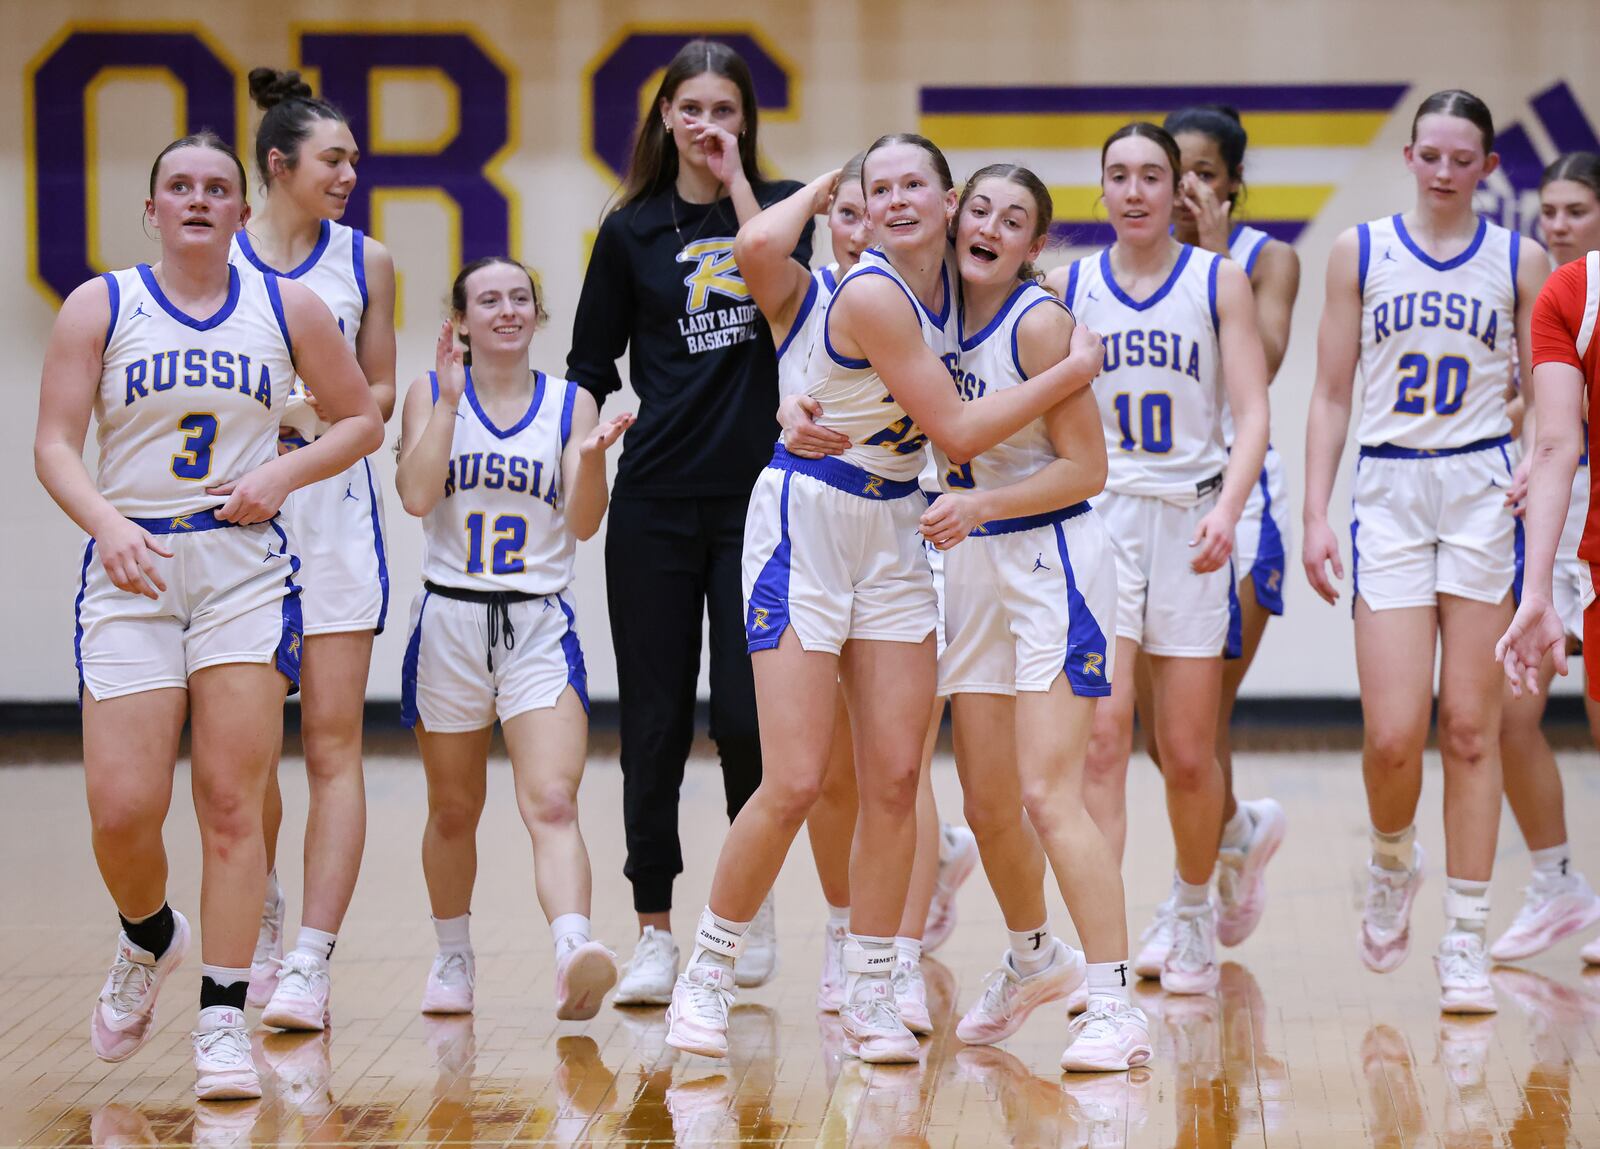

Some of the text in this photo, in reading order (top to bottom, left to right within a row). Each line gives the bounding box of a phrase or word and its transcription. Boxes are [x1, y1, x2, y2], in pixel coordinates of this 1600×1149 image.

[678, 311, 716, 336] LADY
[1373, 290, 1498, 352] RUSSIA
[124, 348, 273, 411] RUSSIA
[1097, 329, 1201, 383] USSIA
[1391, 352, 1472, 419] 20
[169, 411, 221, 482] 3
[1113, 390, 1174, 455] 10
[464, 511, 529, 575] 12
[752, 607, 771, 632] R
[1082, 651, 1103, 677] R
